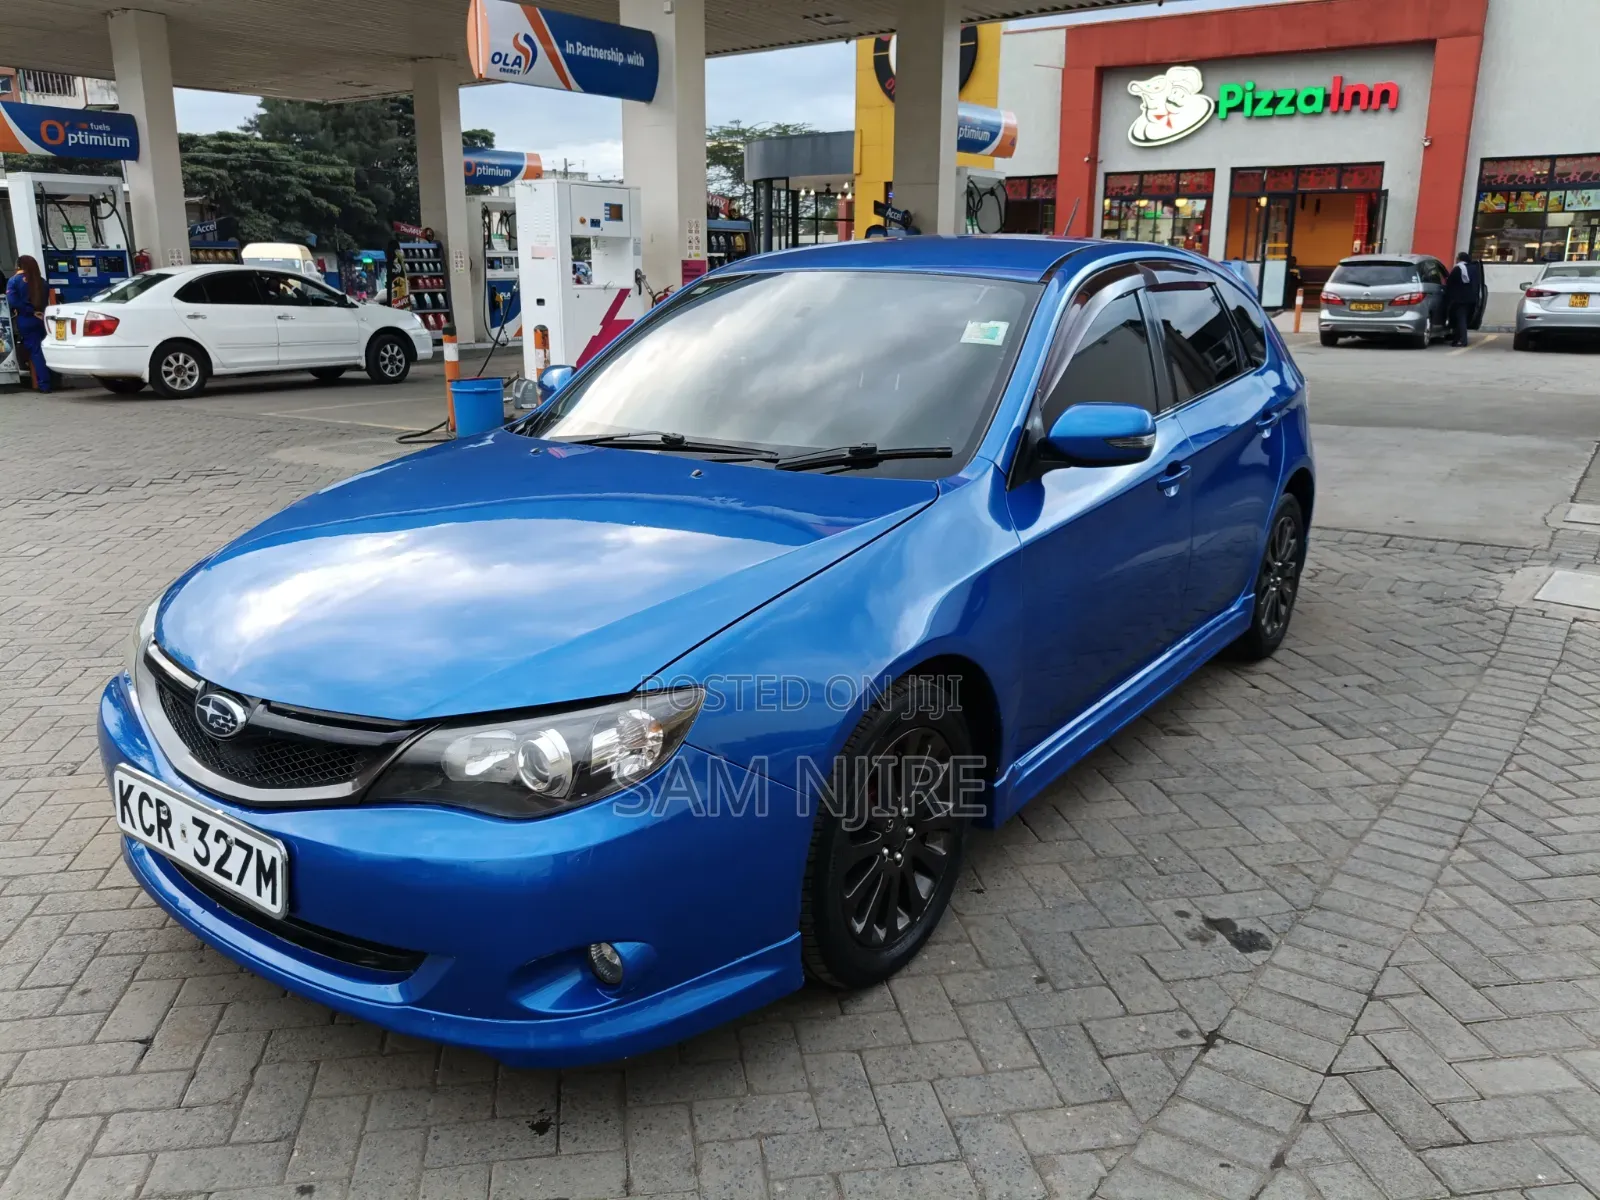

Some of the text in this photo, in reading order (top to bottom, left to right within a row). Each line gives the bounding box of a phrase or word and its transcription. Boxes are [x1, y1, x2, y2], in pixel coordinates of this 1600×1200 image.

[491, 51, 523, 69] OLA
[565, 40, 645, 67] In Partnership with
[499, 67, 522, 75] ENERGY
[90, 122, 111, 131] fuels
[886, 207, 903, 221] Accel
[195, 221, 217, 234] Accel
[118, 779, 277, 906] KCR 327M
